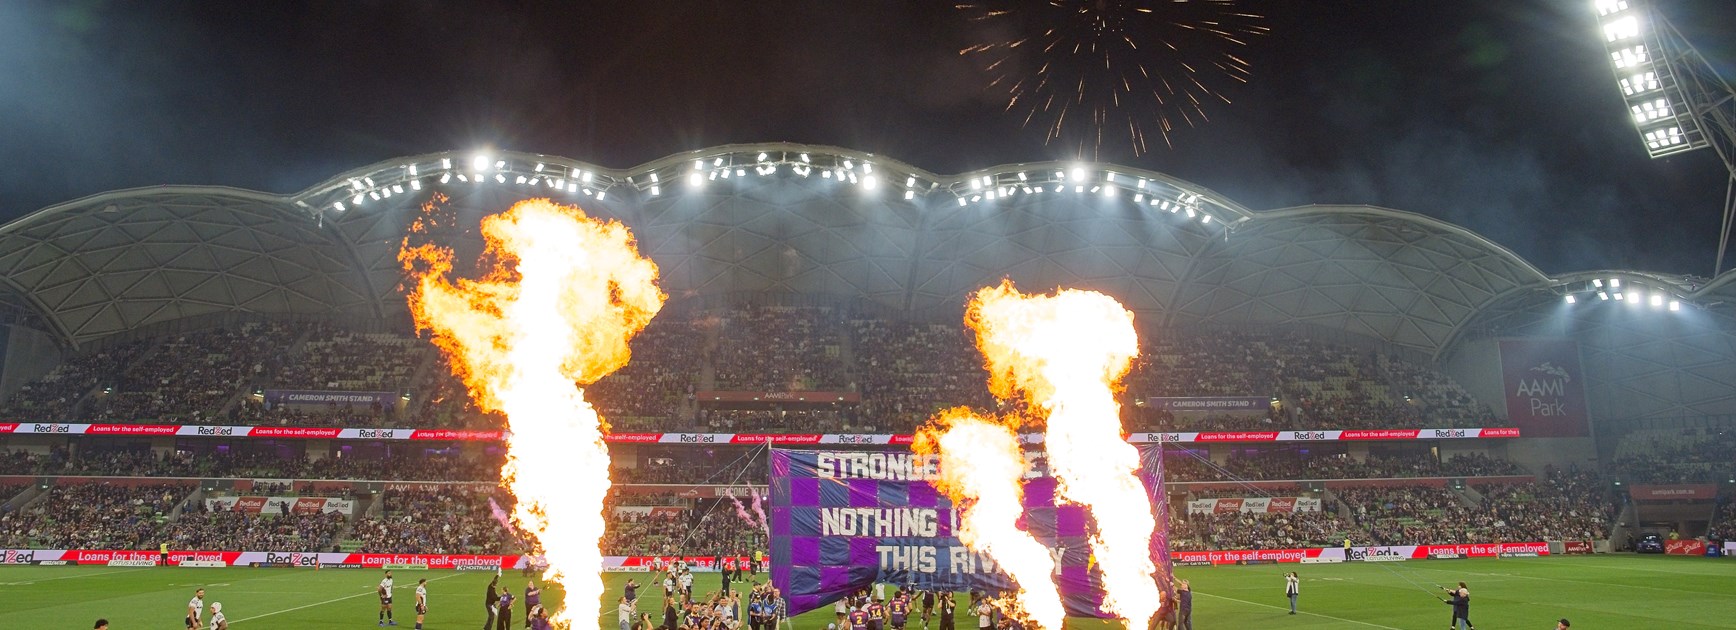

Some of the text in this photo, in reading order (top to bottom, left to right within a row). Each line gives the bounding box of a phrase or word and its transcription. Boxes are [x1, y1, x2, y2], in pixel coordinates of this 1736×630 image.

[1516, 378, 1563, 397] AAMI
[325, 394, 348, 402] SMITH
[1530, 397, 1566, 416] Park
[34, 423, 69, 432] RedZed
[132, 425, 174, 433] self-employed
[198, 426, 232, 435] RedZed
[359, 429, 393, 438] RedZed
[680, 433, 714, 442] RedZed
[775, 434, 817, 442] self-employed
[1236, 432, 1274, 440] self-employed
[1294, 431, 1325, 440] RedZed
[1379, 430, 1415, 438] self-employed
[1435, 429, 1465, 438] RedZed
[817, 452, 942, 481] STRONGE
[715, 487, 749, 497] WECOME
[760, 487, 770, 497] AA
[821, 507, 937, 538] NOTHING
[1428, 547, 1454, 556] Loans
[1456, 546, 1468, 555] for
[1471, 546, 1486, 555] the
[1487, 543, 1549, 555] self-employed
[0, 551, 35, 563] dZed
[79, 552, 108, 561] Loans
[112, 552, 127, 561] for
[129, 552, 149, 561] the
[266, 552, 319, 566] RedZed
[361, 555, 502, 566] Loans for the self-employed
[875, 545, 937, 573] THIS
[1179, 552, 1207, 562] Loans
[1209, 552, 1222, 561] for
[1224, 552, 1240, 561] the
[1242, 550, 1306, 562] self-employed
[640, 557, 669, 567] Lons
[895, 604, 901, 612] 5
[871, 609, 881, 617] 14
[856, 615, 863, 625] 2
